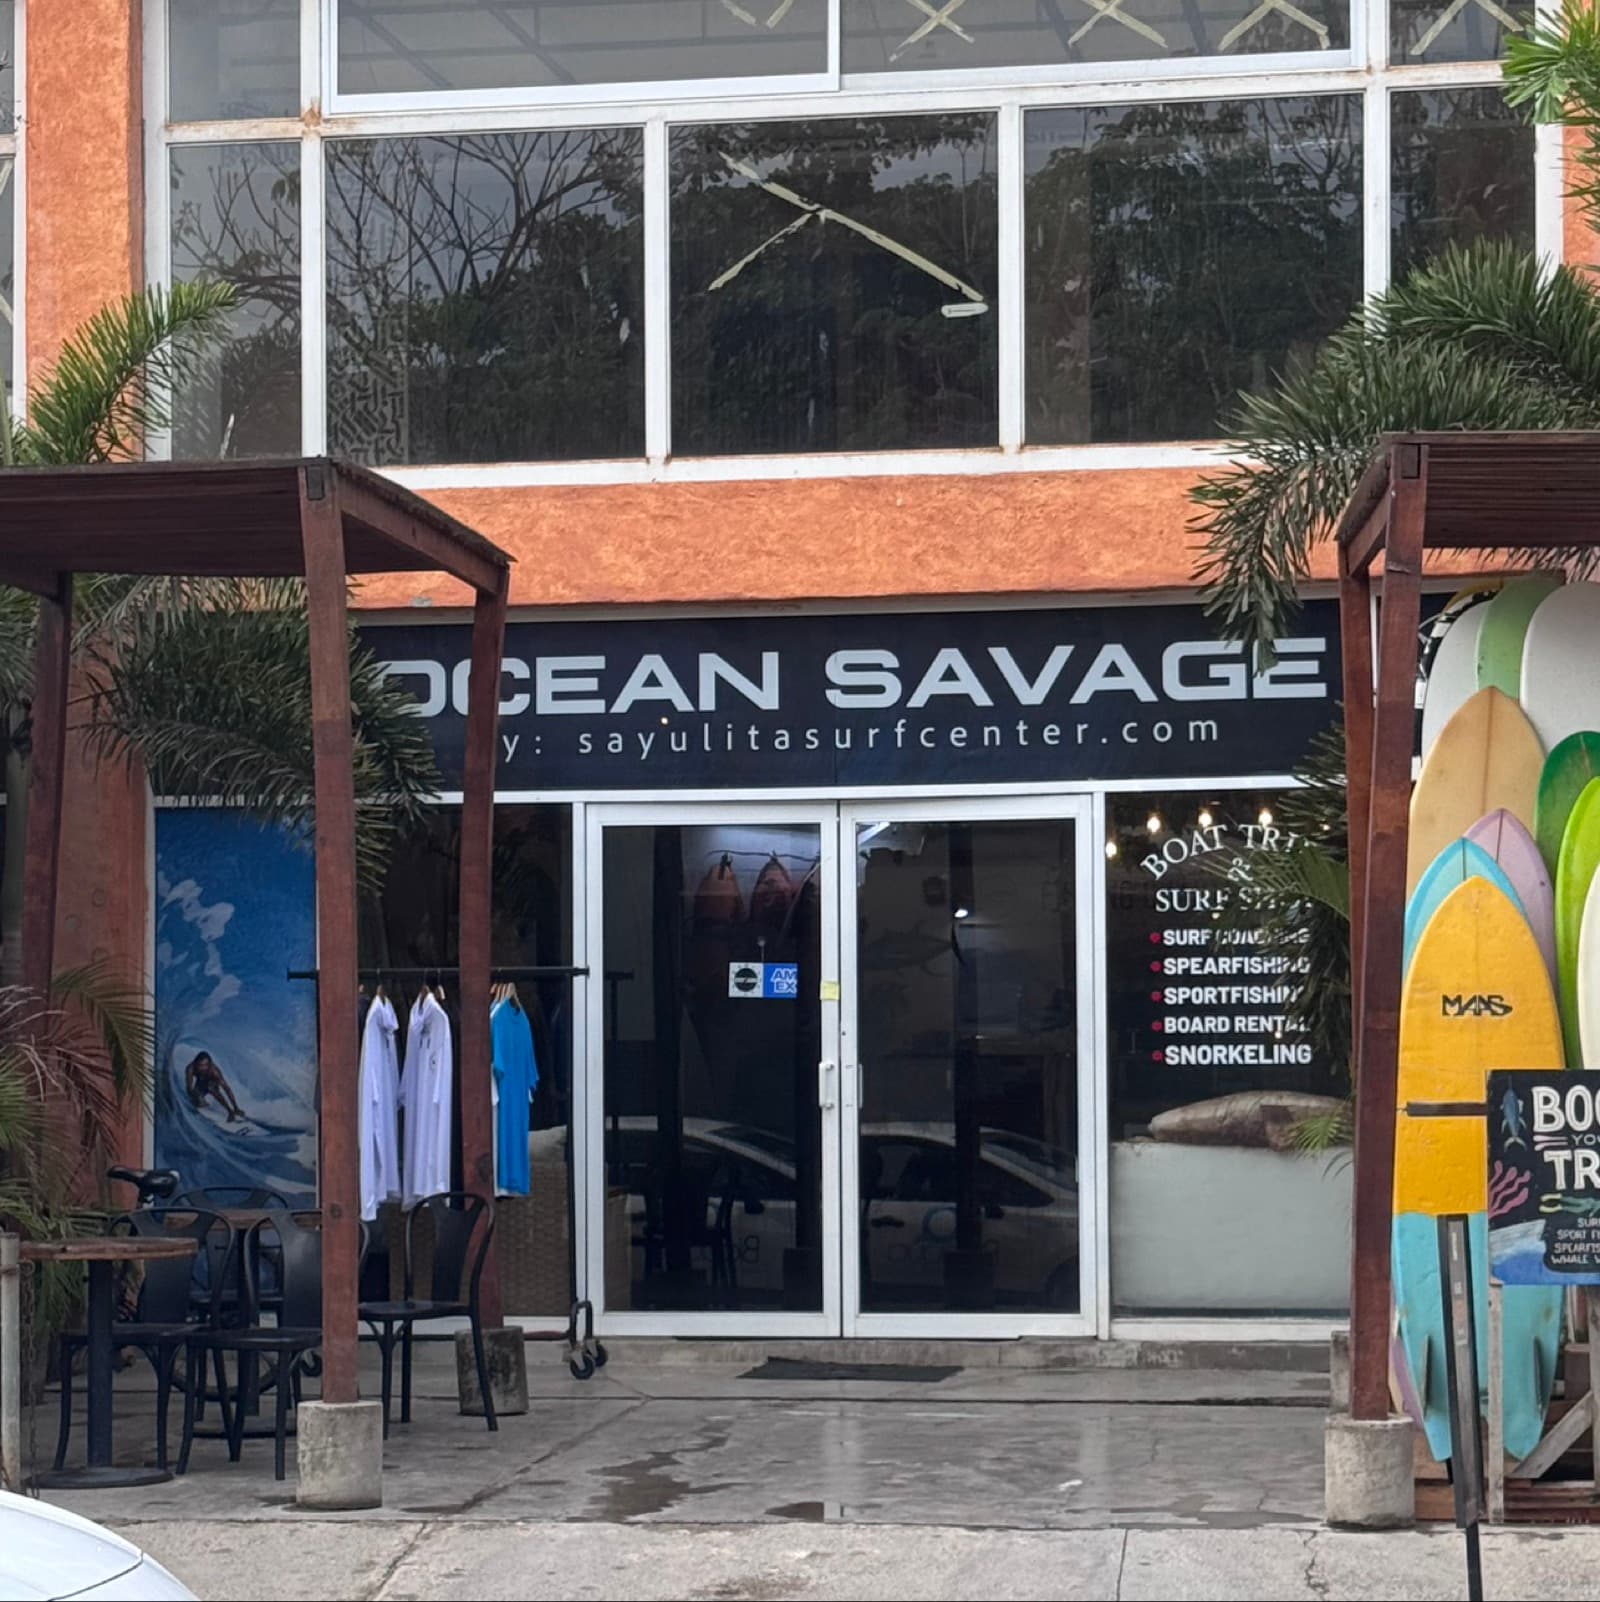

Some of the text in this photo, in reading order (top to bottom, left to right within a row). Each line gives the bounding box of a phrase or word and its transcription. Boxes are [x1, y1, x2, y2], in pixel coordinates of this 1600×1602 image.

[371, 637, 1327, 718] OCEAN SAVAGE
[502, 718, 1218, 763] y: sayulitasurfcenter.com
[1139, 824, 1316, 880] BOAT TRI
[1227, 857, 1253, 882] &
[1155, 887, 1230, 912] SURF
[1163, 929, 1212, 946] SURF
[770, 968, 798, 982] AM
[774, 980, 798, 994] EX
[1164, 985, 1305, 1005] SPORTFISHIN
[1442, 995, 1513, 1016] MAAS
[1164, 1016, 1230, 1034] BOARD
[1165, 1044, 1312, 1065] SNORKELING
[1532, 1085, 1600, 1132] BO
[1544, 1149, 1600, 1190] TR
[1556, 1229, 1586, 1240] SPORT
[1551, 1254, 1588, 1264] WHALE
